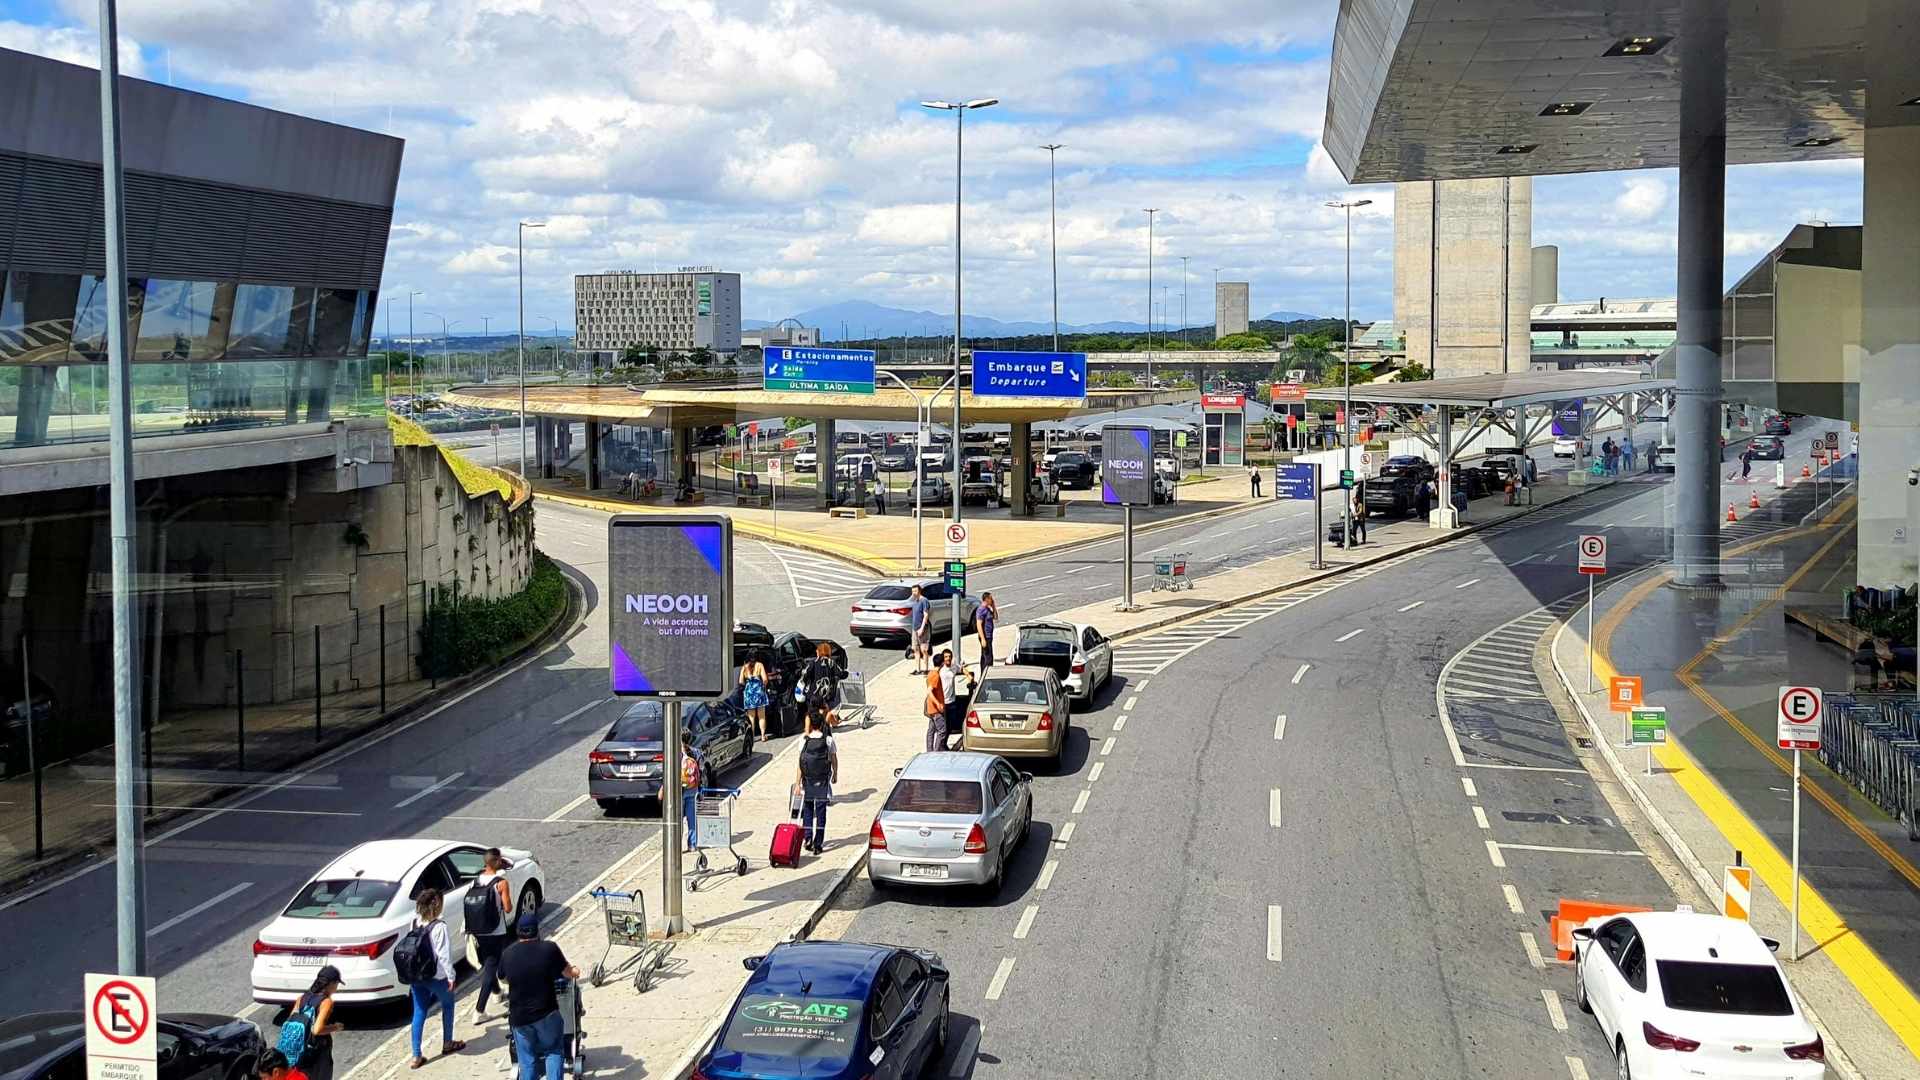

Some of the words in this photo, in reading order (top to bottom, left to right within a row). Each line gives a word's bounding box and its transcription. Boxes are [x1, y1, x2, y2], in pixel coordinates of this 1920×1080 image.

[795, 352, 873, 362] Estacionamentos
[988, 362, 1047, 374] Embarque
[790, 380, 818, 390] ÚLTIMA
[824, 382, 849, 391] SAÍDA
[990, 376, 1047, 387] Departure
[1108, 459, 1144, 470] NEOOH
[1589, 542, 1597, 553] E
[626, 594, 708, 613] NEOOH
[643, 618, 650, 626] A
[652, 618, 670, 626] vida
[671, 618, 709, 626] acontece
[658, 628, 673, 636] out
[674, 628, 683, 636] of
[685, 628, 709, 636] home
[1793, 696, 1807, 716] E
[803, 1003, 849, 1019] ATS
[104, 1062, 141, 1072] PERMITIDO
[100, 1071, 138, 1080] EMBARQUE
